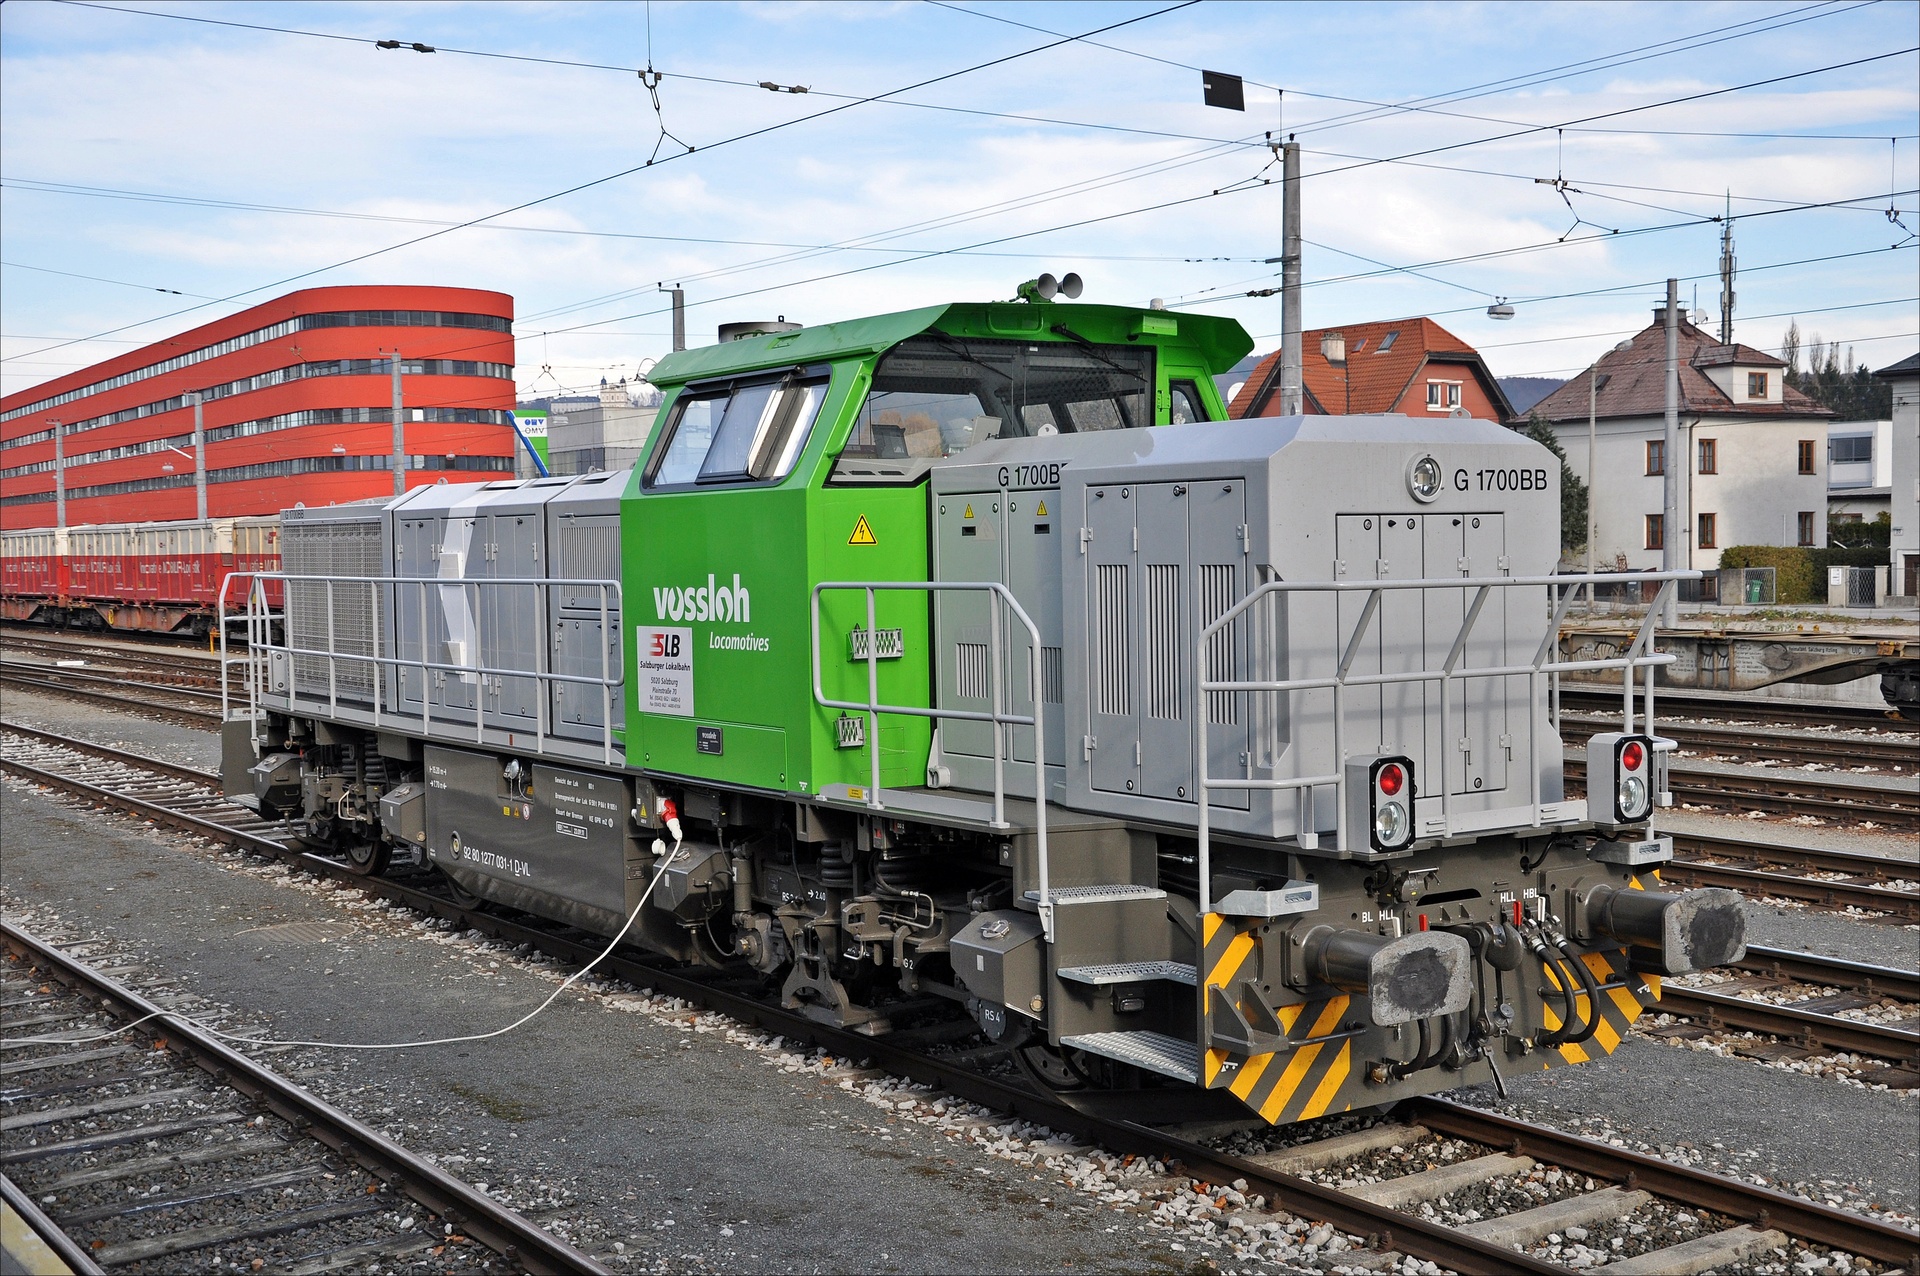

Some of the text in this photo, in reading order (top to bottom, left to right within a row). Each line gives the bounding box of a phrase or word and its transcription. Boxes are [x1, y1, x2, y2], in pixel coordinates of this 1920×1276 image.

[998, 464, 1065, 487] G 1700B
[1454, 469, 1547, 491] G 1700BB
[285, 510, 289, 520] G
[653, 574, 750, 623] vossloh
[649, 634, 680, 657] SLB
[710, 632, 770, 651] Locomotives
[640, 660, 691, 672] Salzburger Lokalbahn
[661, 677, 678, 687] Salzburg
[464, 846, 531, 877] 92 80 1277 031-1 D-VL
[1500, 892, 1516, 903] HLL
[1523, 888, 1539, 899] HBL
[1362, 911, 1373, 923] BL
[1379, 909, 1395, 921] HLL
[903, 958, 914, 970] G 2
[985, 1009, 1000, 1022] RS 4
